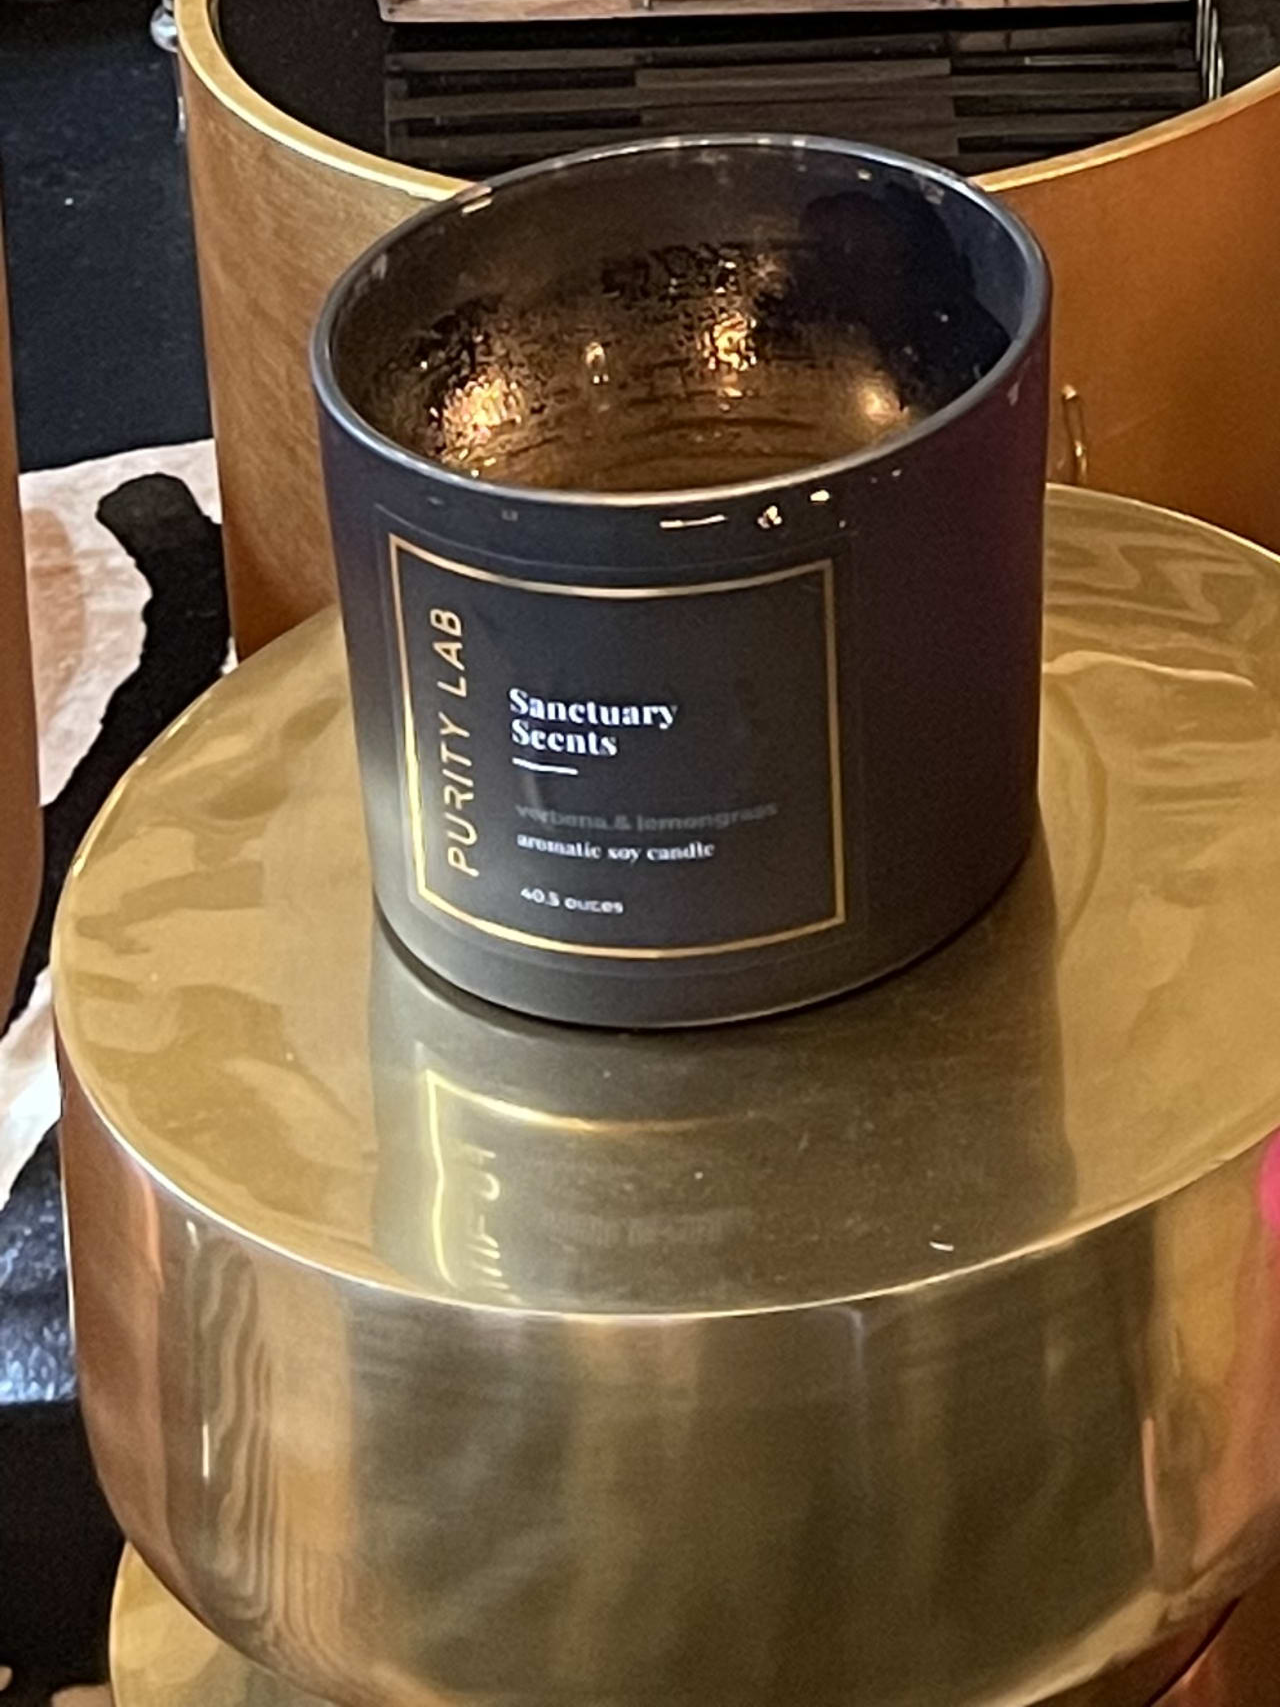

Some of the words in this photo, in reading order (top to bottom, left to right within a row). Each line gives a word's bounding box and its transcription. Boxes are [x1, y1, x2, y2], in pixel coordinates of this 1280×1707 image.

[430, 607, 466, 698] LAB
[509, 688, 678, 730] Sanctuary
[512, 720, 618, 756] Scents
[437, 711, 479, 878] PURITY
[614, 815, 631, 829] &
[638, 802, 778, 832] lemongrass
[517, 834, 602, 860] aromatic
[607, 845, 640, 863] soy
[647, 839, 715, 861] candle
[520, 886, 560, 907] 40.5
[565, 895, 624, 914] ounces
